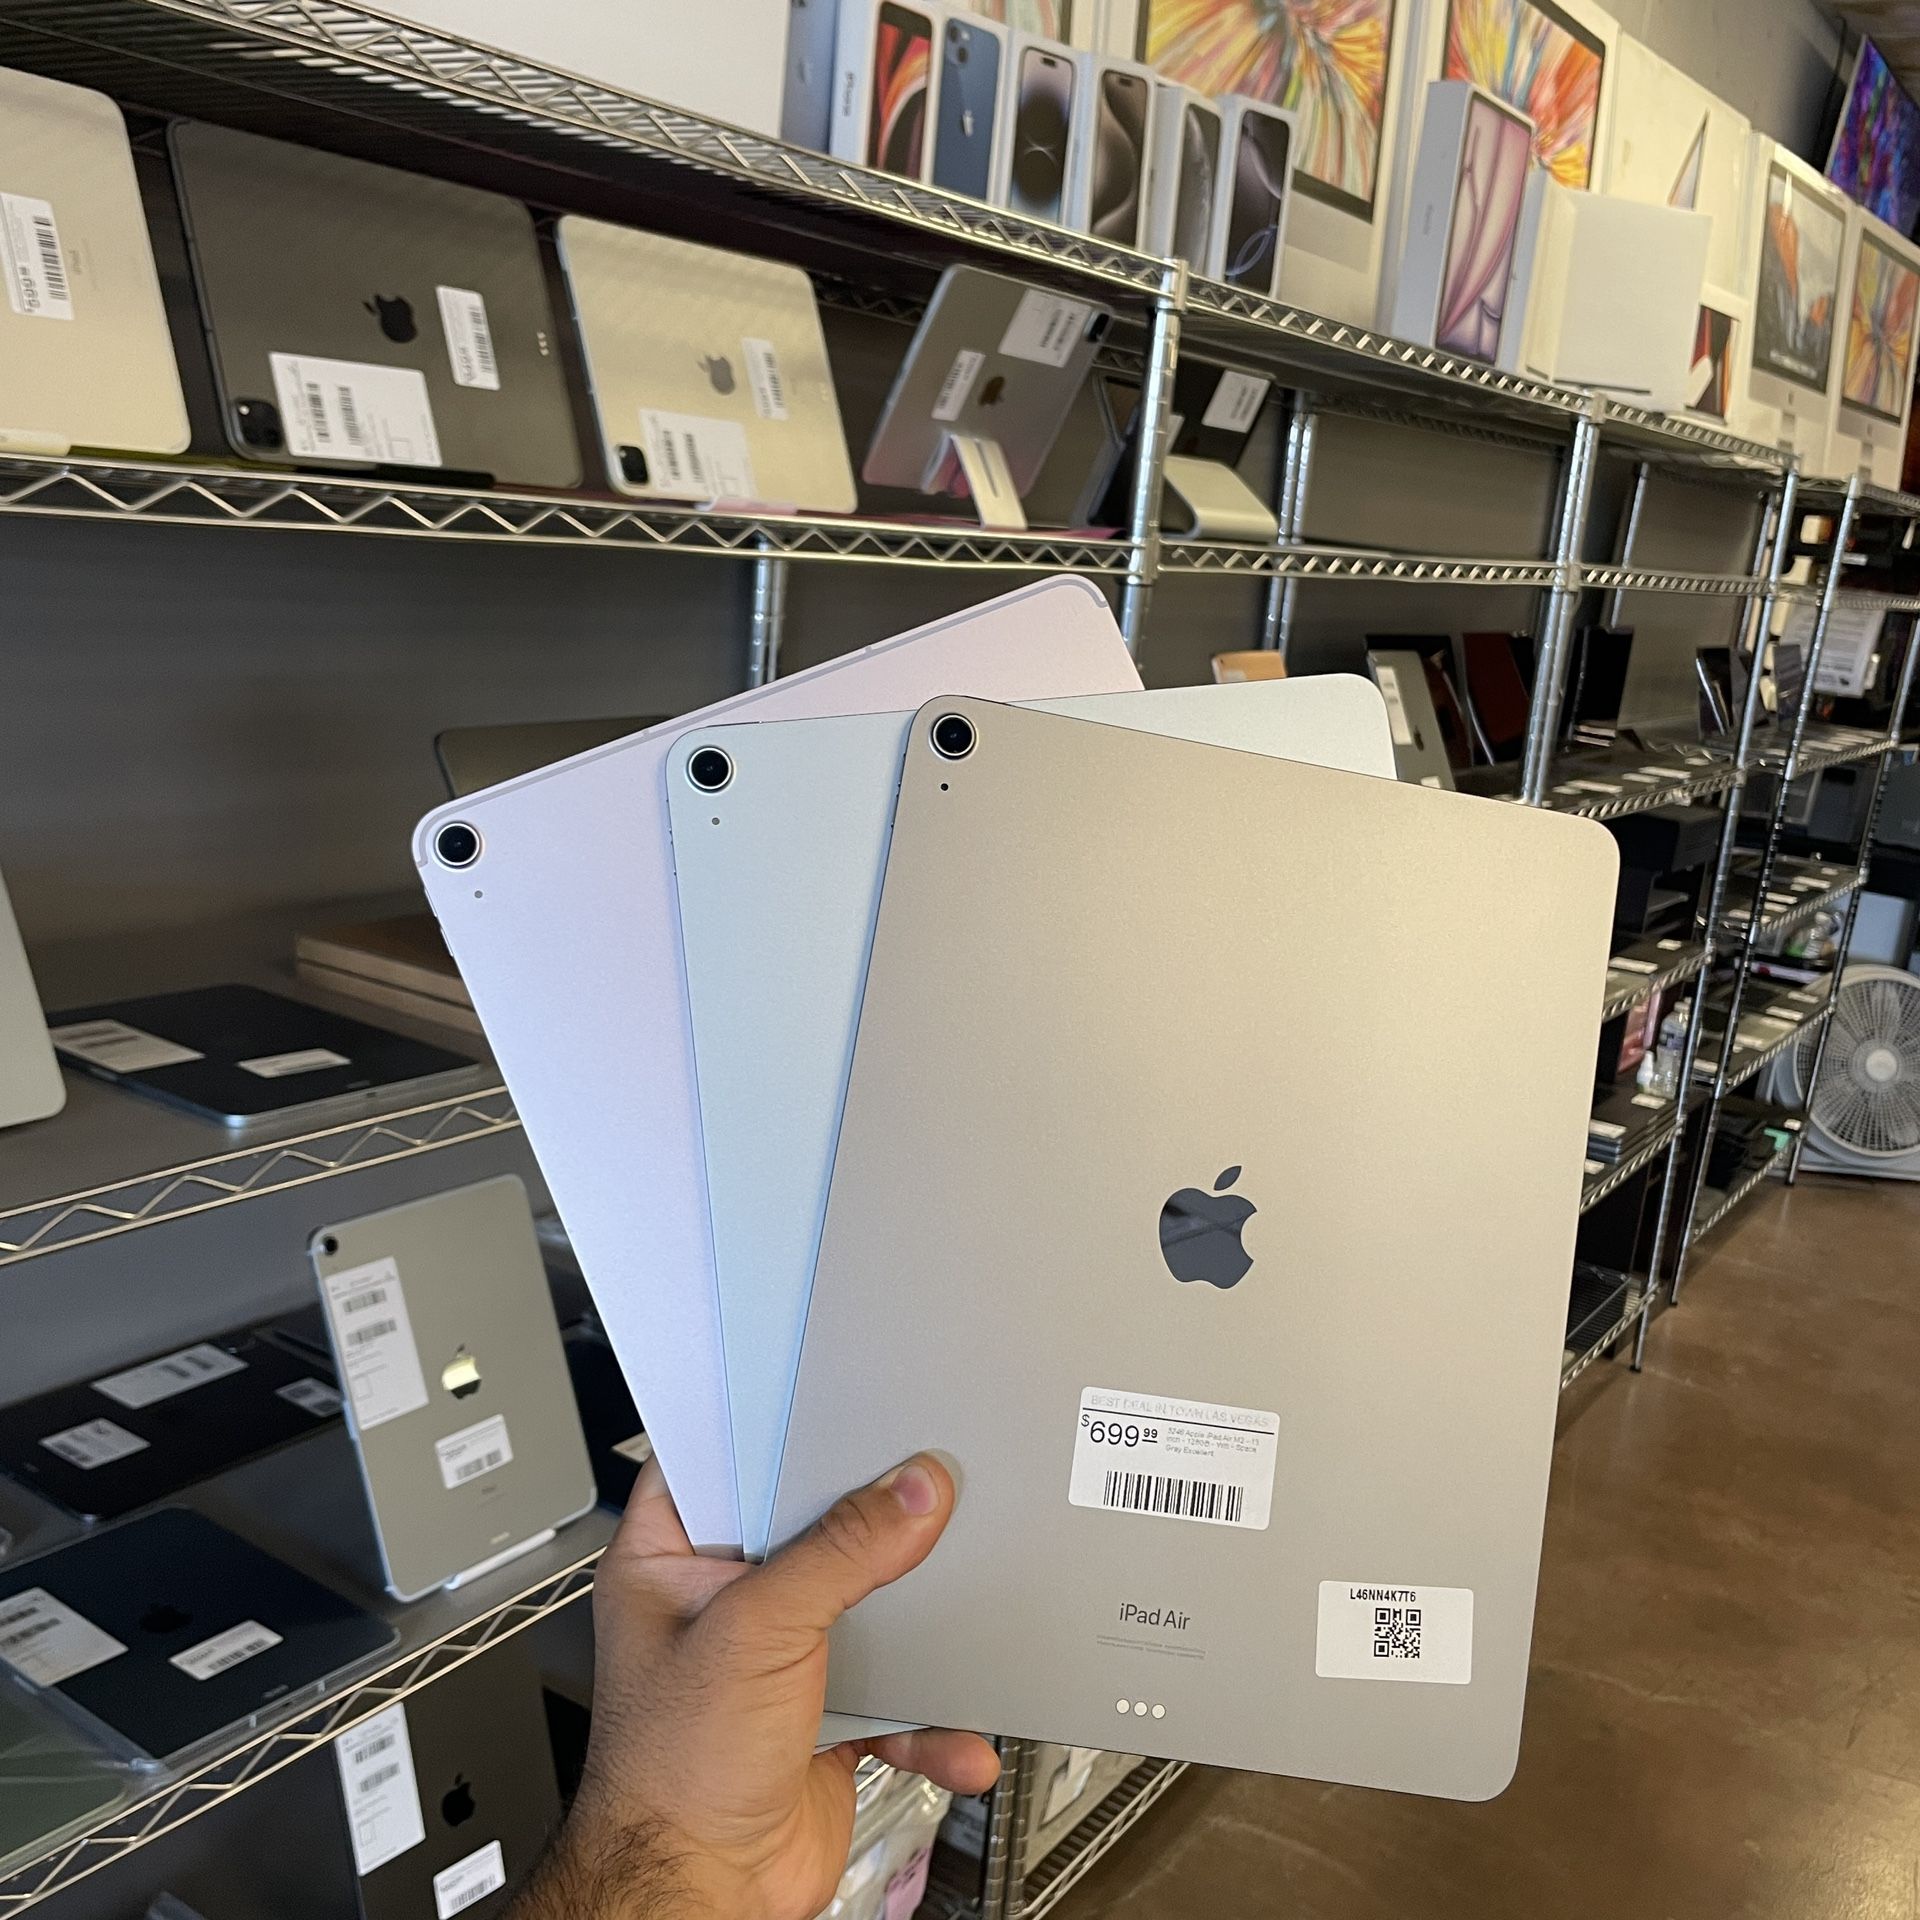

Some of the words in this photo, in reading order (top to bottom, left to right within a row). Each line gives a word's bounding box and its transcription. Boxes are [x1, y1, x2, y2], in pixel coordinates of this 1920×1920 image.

[1091, 1394, 1120, 1408] BEST
[1155, 1402, 1167, 1414] IN
[1205, 1409, 1227, 1423] LAS
[1230, 1412, 1269, 1427] VEGAS
[1350, 1588, 1416, 1602] L46NN4K7T6
[1119, 1603, 1161, 1626] iPad
[1163, 1610, 1191, 1630] Air
